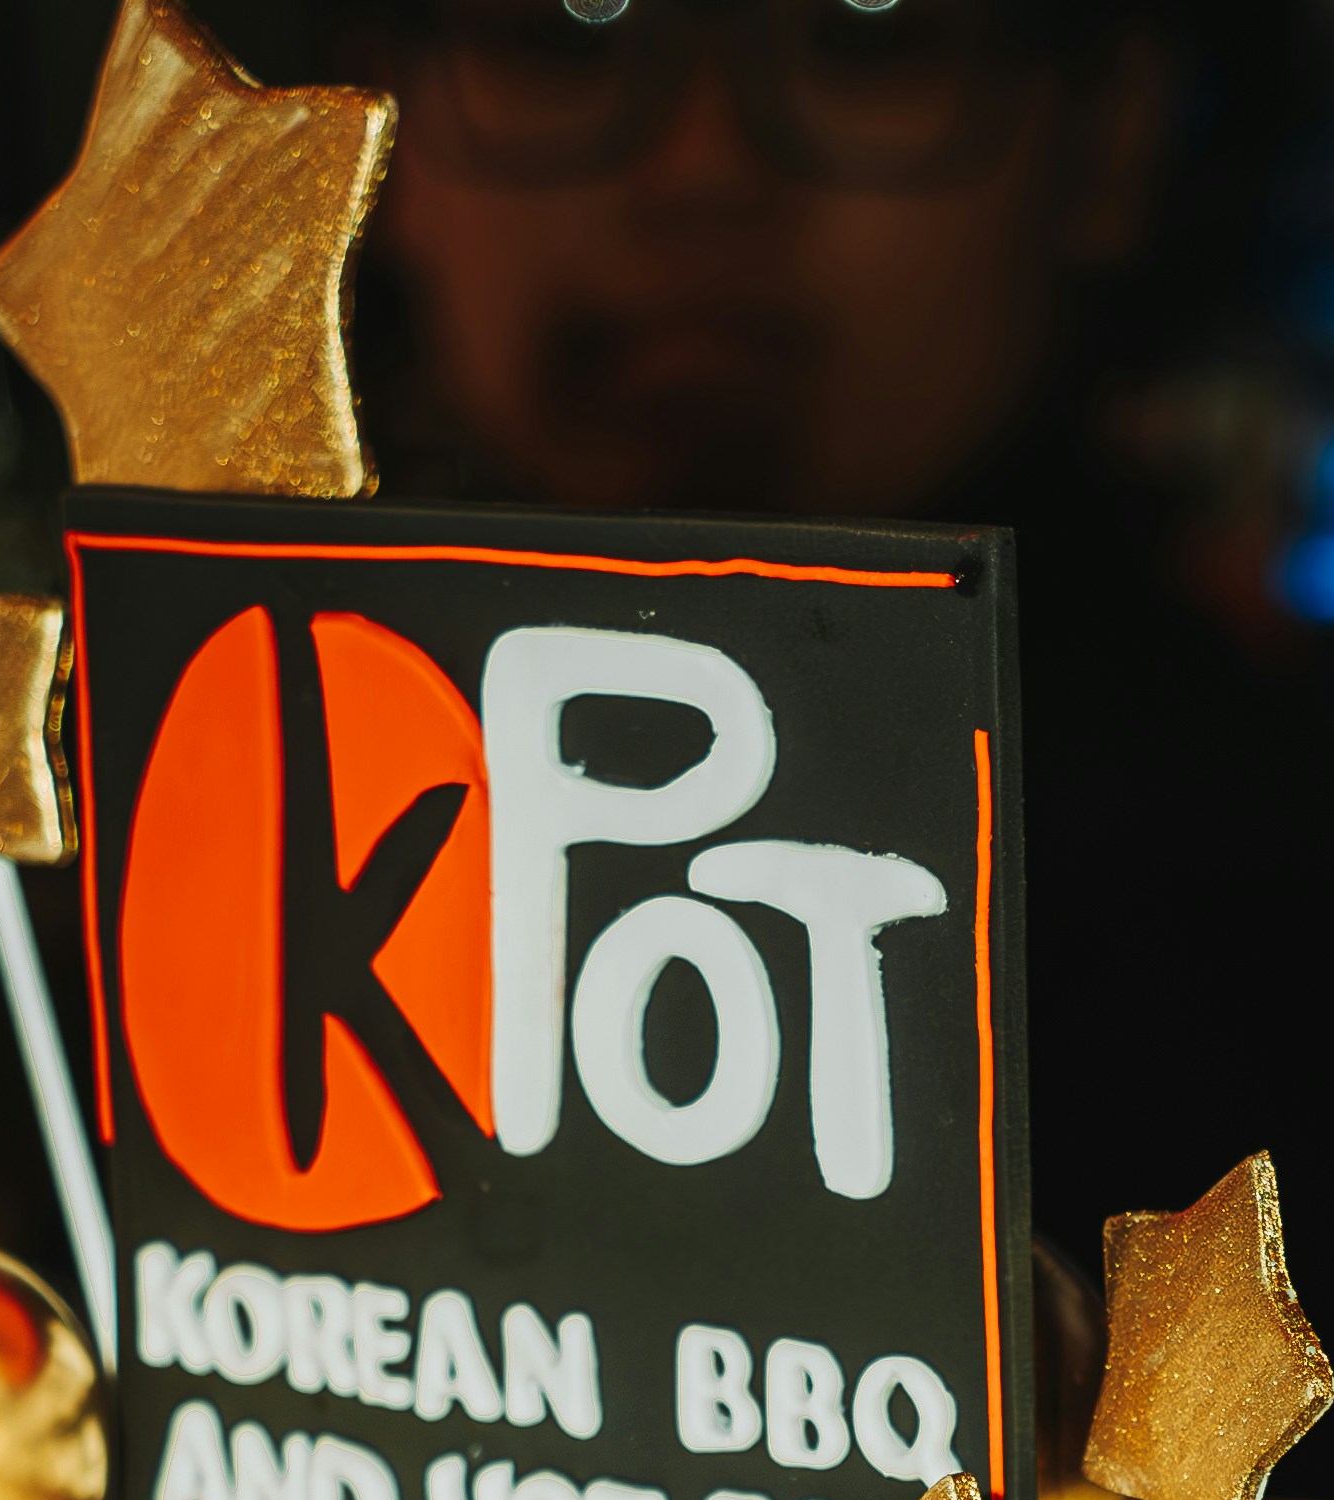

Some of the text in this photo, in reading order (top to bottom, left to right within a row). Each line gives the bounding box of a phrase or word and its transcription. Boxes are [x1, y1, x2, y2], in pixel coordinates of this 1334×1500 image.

[122, 605, 947, 1233] KPOT
[133, 1240, 967, 1490] KOREAN BBQ
